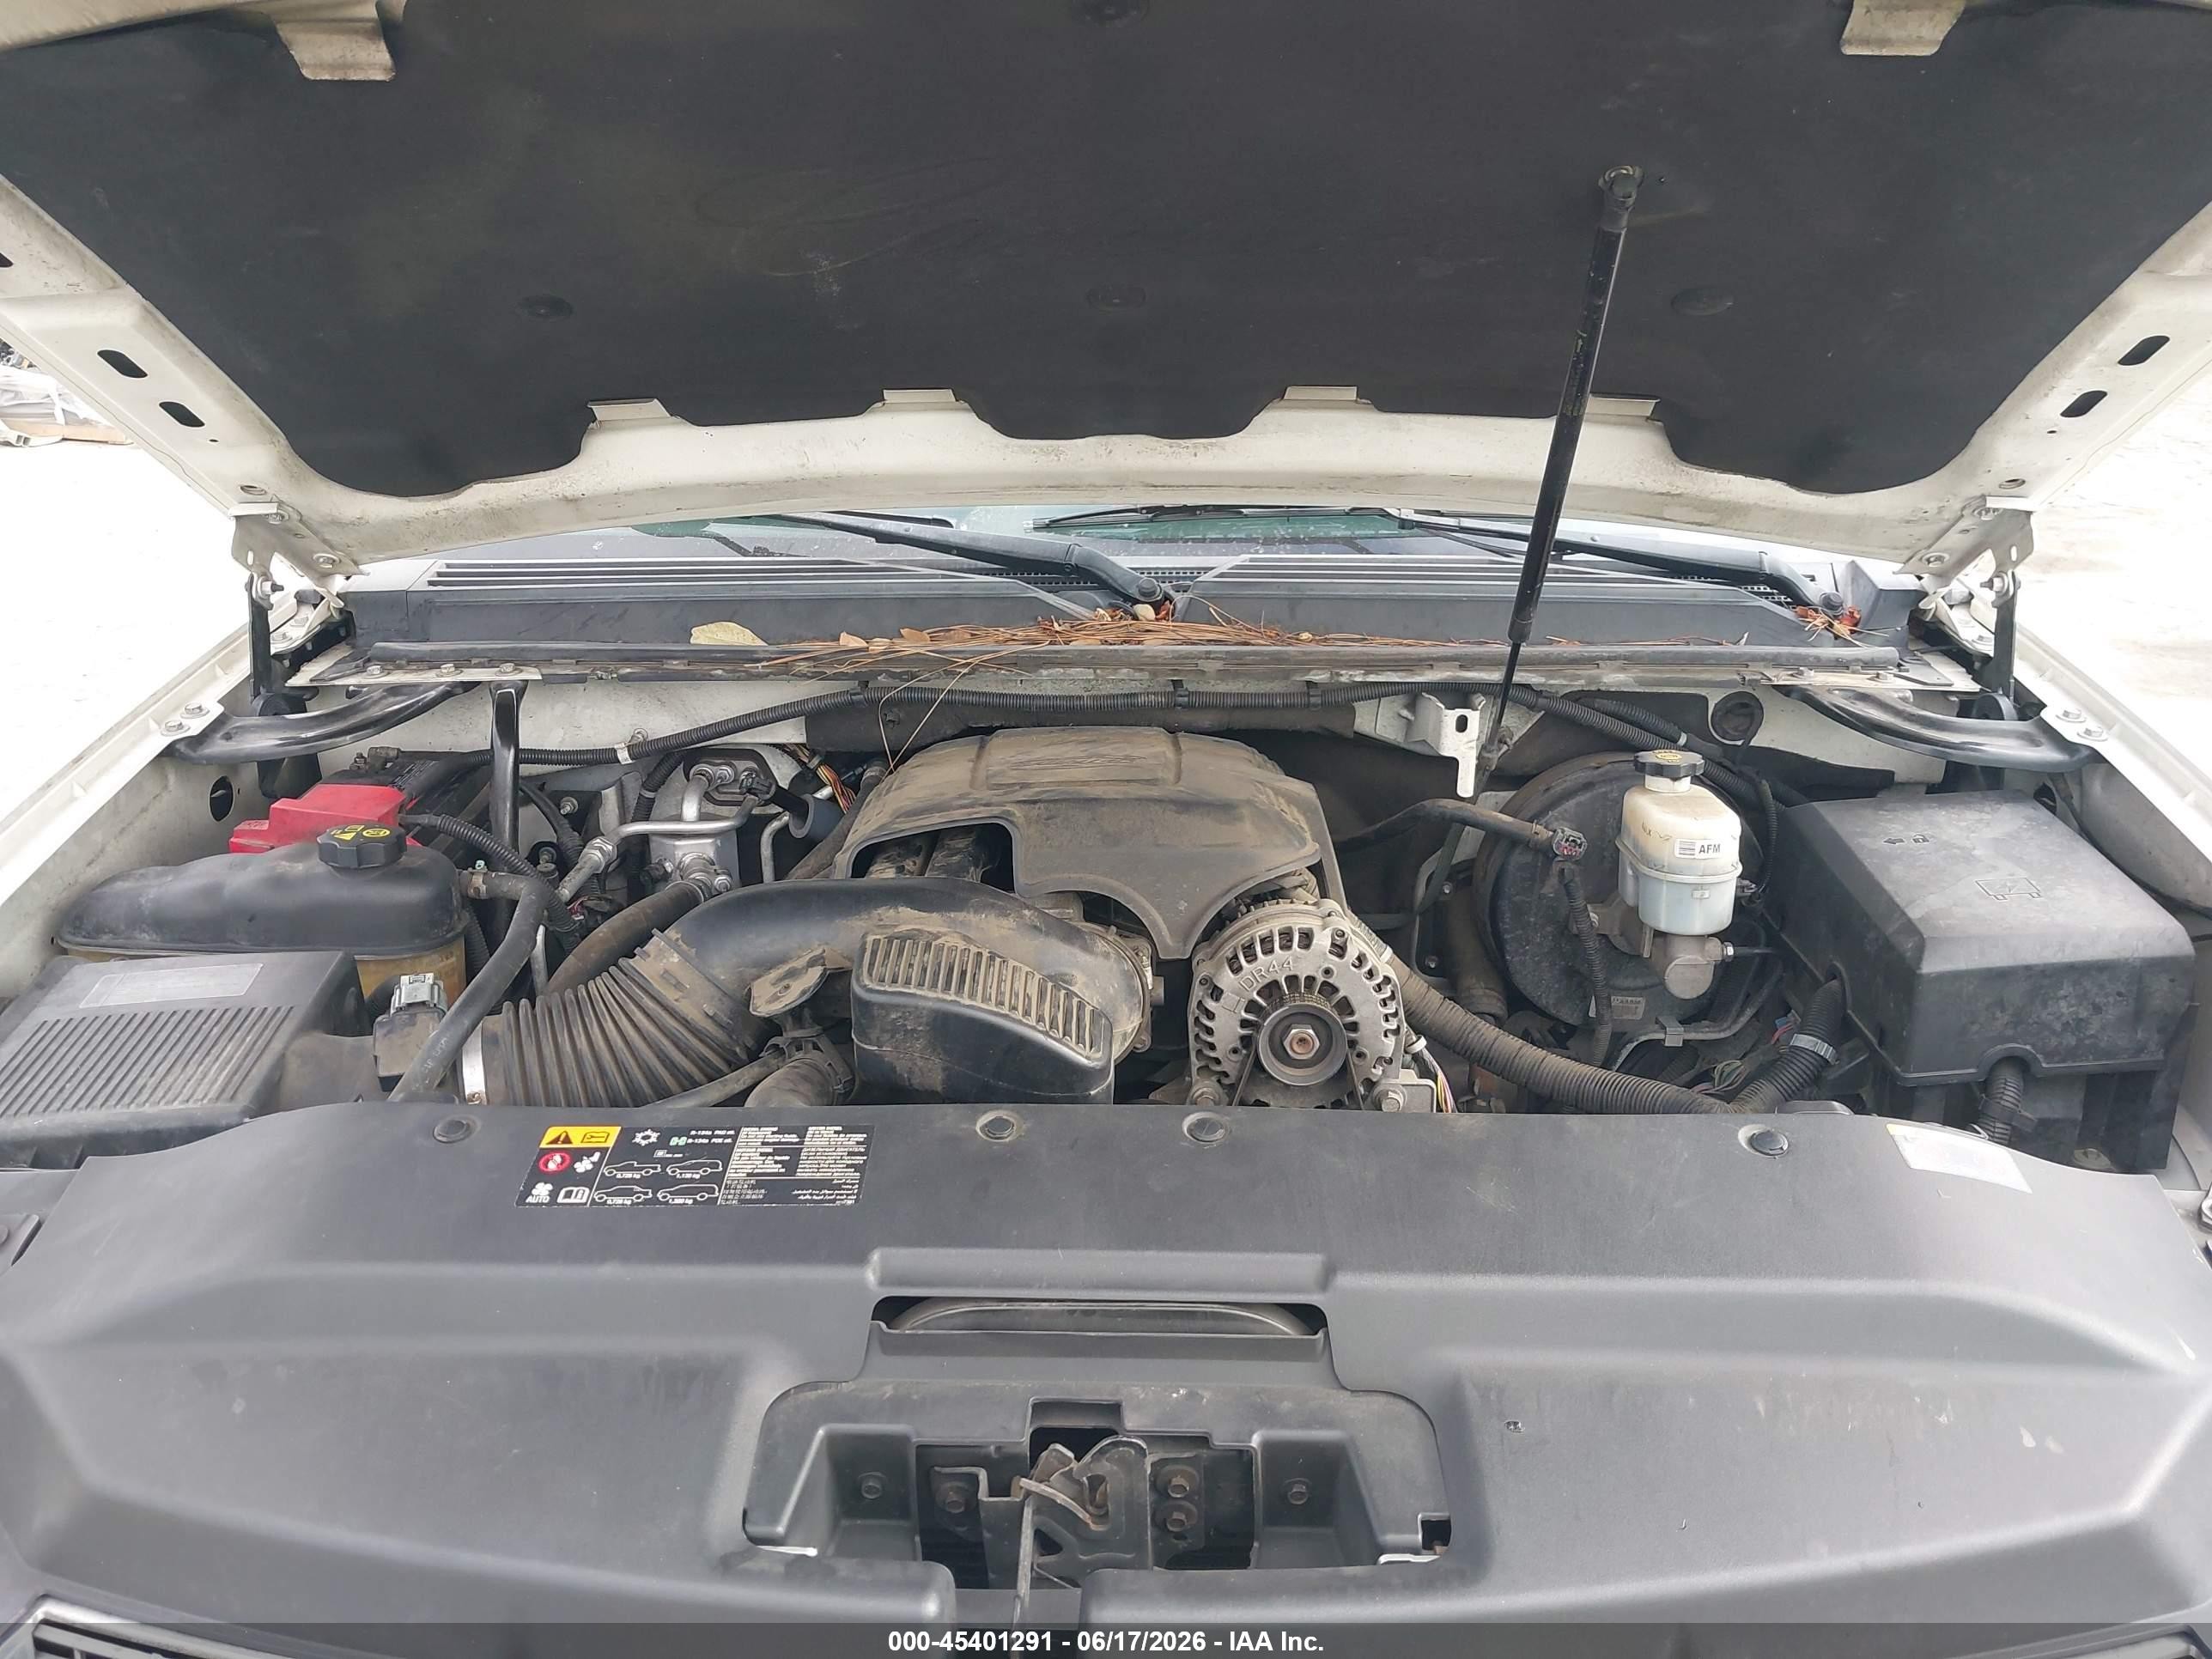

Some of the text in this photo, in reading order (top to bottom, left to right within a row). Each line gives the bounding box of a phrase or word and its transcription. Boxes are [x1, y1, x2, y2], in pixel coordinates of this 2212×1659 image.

[1698, 844, 1722, 854] AFM
[1238, 955, 1294, 992] DR44
[525, 1194, 550, 1203] AUTO
